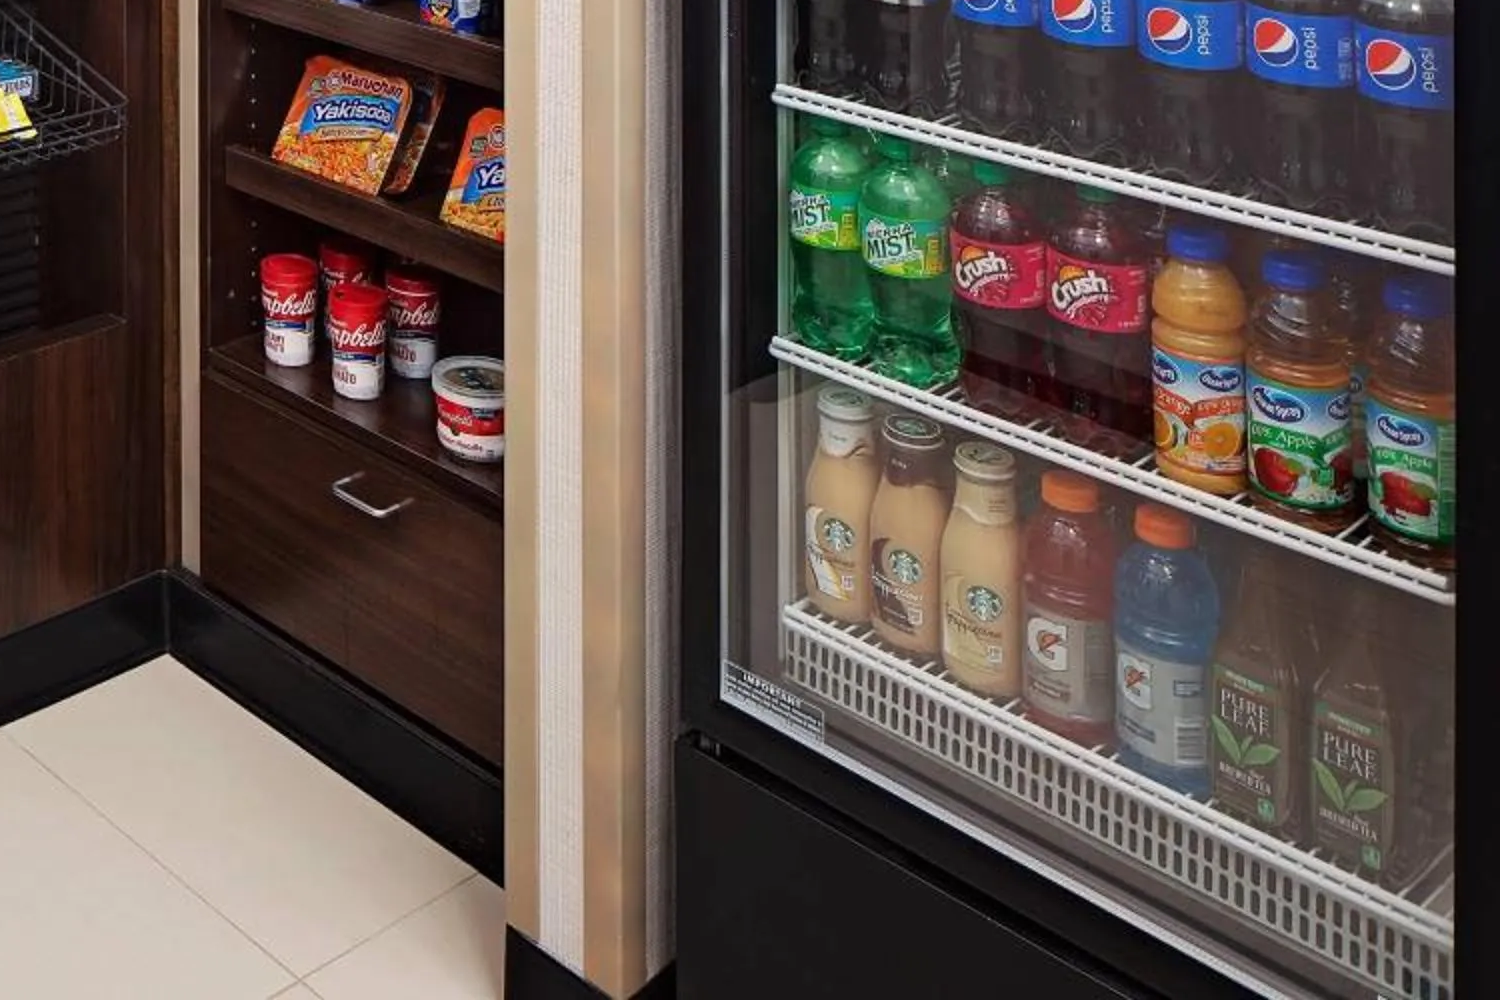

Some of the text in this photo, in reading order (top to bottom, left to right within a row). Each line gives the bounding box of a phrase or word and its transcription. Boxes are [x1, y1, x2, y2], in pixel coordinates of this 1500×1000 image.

[1197, 14, 1212, 56] pepsi
[1301, 26, 1320, 70] pepsi
[342, 71, 404, 98] Maruchan
[1421, 46, 1439, 93] pepsi
[313, 100, 393, 125] Yakisoba
[867, 231, 915, 259] MIST
[955, 251, 1008, 289] Crush
[1051, 270, 1109, 310] Crush
[1275, 430, 1317, 451] Apple
[1027, 617, 1068, 671] G
[1221, 687, 1269, 720] PURE
[1221, 703, 1270, 737] LEAF
[1323, 731, 1377, 765] PURE
[1323, 747, 1379, 782] LEAF
